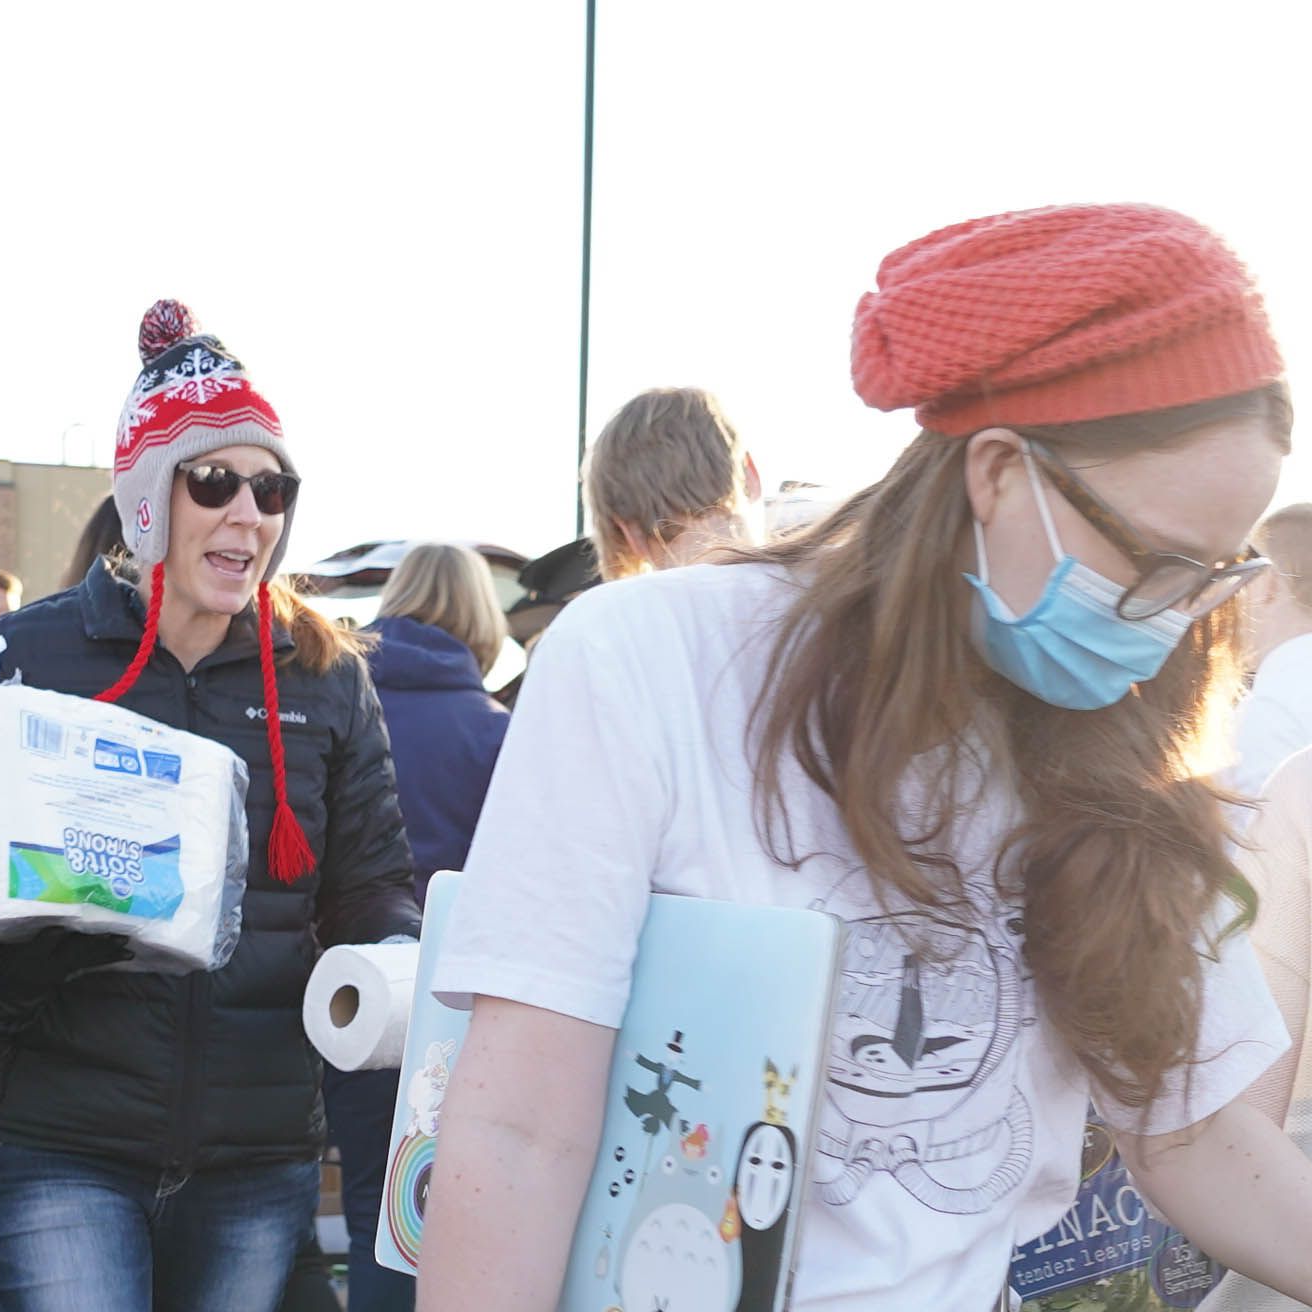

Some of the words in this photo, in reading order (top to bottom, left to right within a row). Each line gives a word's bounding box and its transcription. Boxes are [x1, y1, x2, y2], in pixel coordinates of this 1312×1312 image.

[63, 827, 143, 861] STRONG
[1011, 1185, 1155, 1262] INAC
[1016, 1255, 1076, 1285] tender
[1079, 1235, 1153, 1266] leaves
